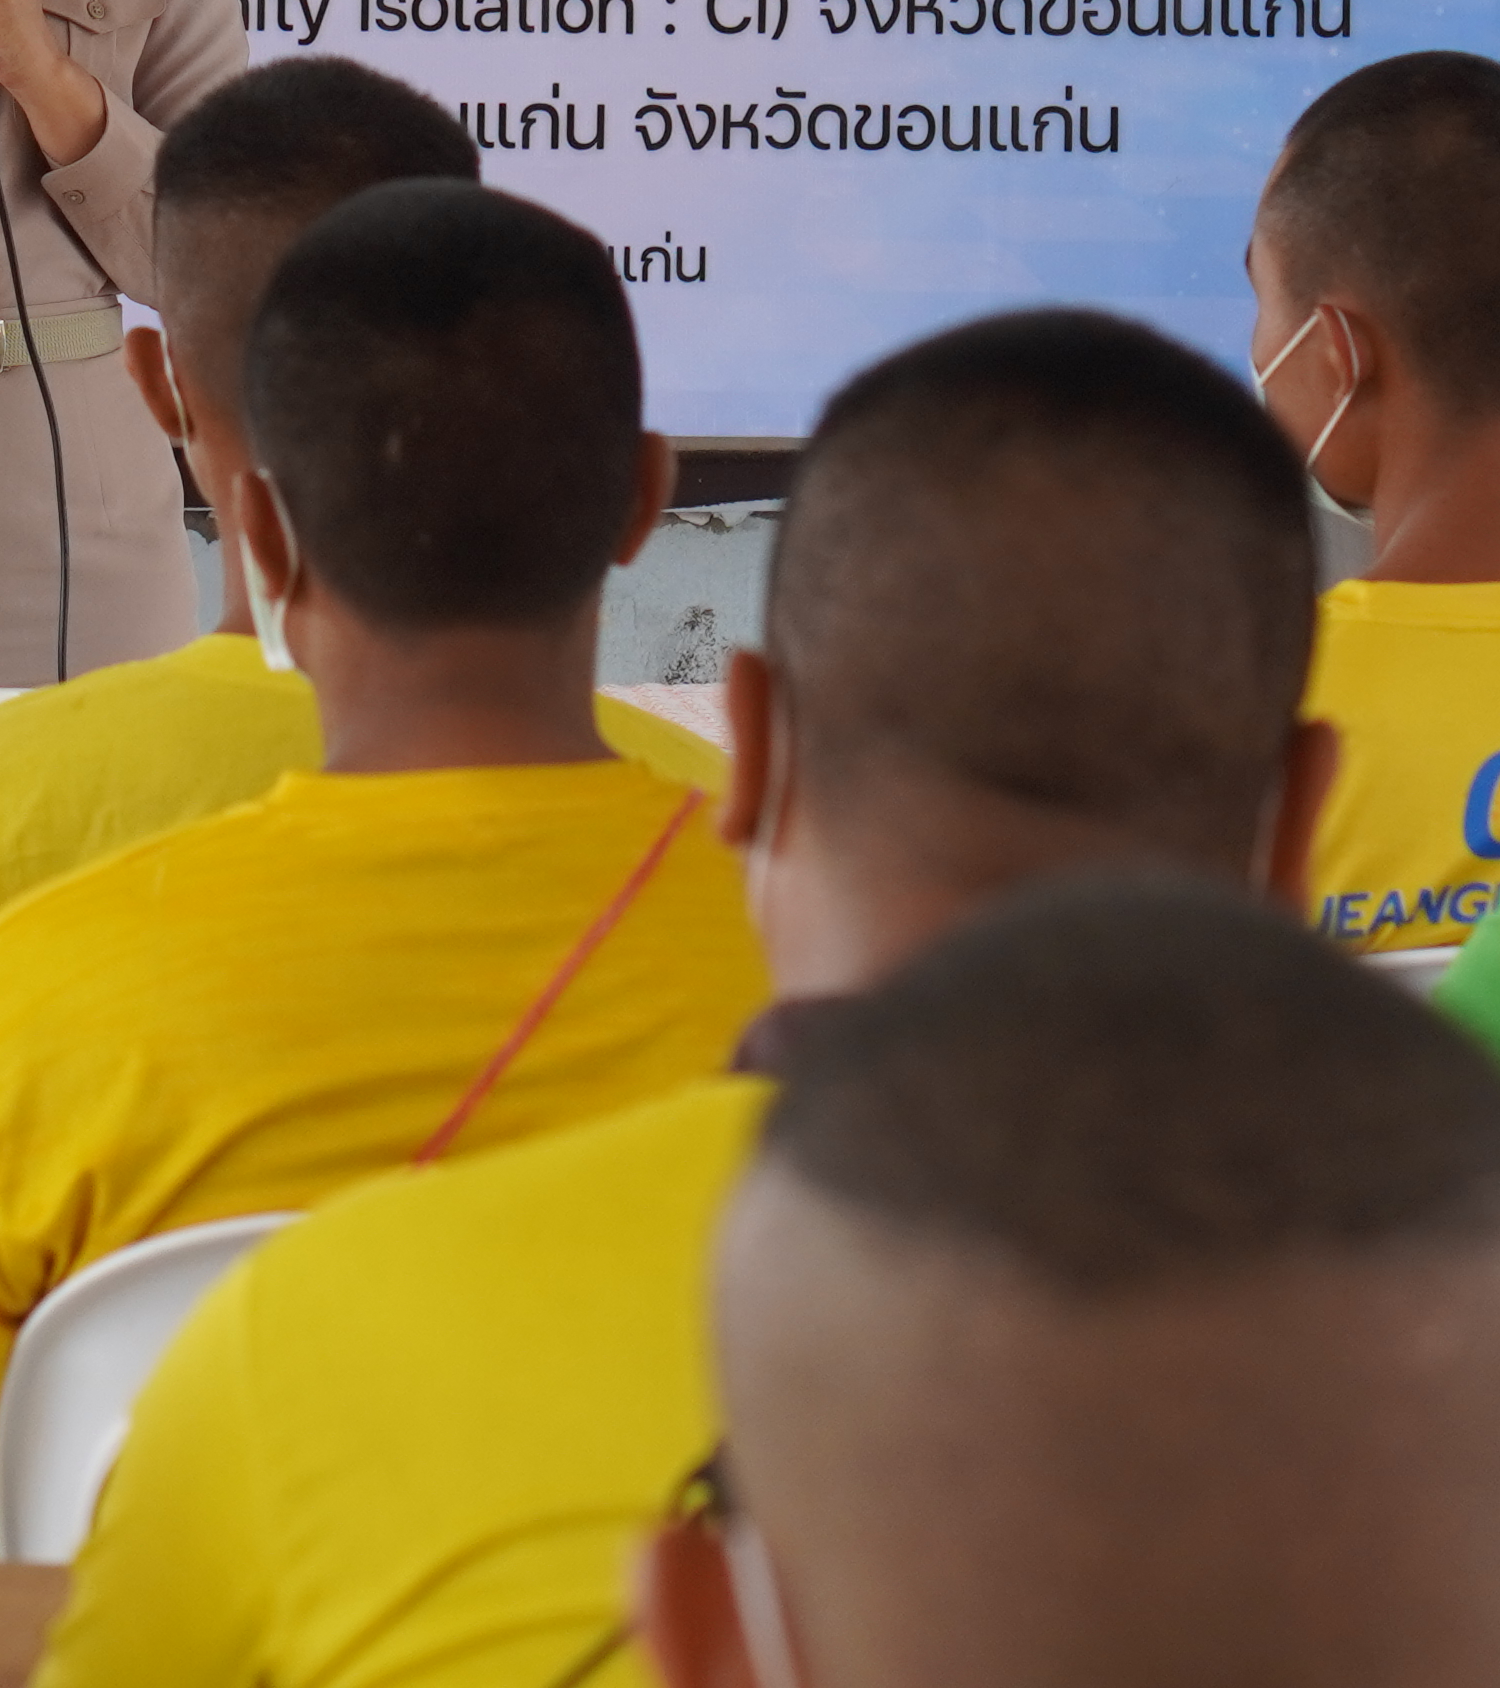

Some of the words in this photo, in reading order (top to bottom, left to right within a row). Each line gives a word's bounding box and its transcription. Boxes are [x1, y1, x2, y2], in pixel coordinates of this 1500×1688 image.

[634, 86, 1120, 152] จังหวัดขอนแก่น
